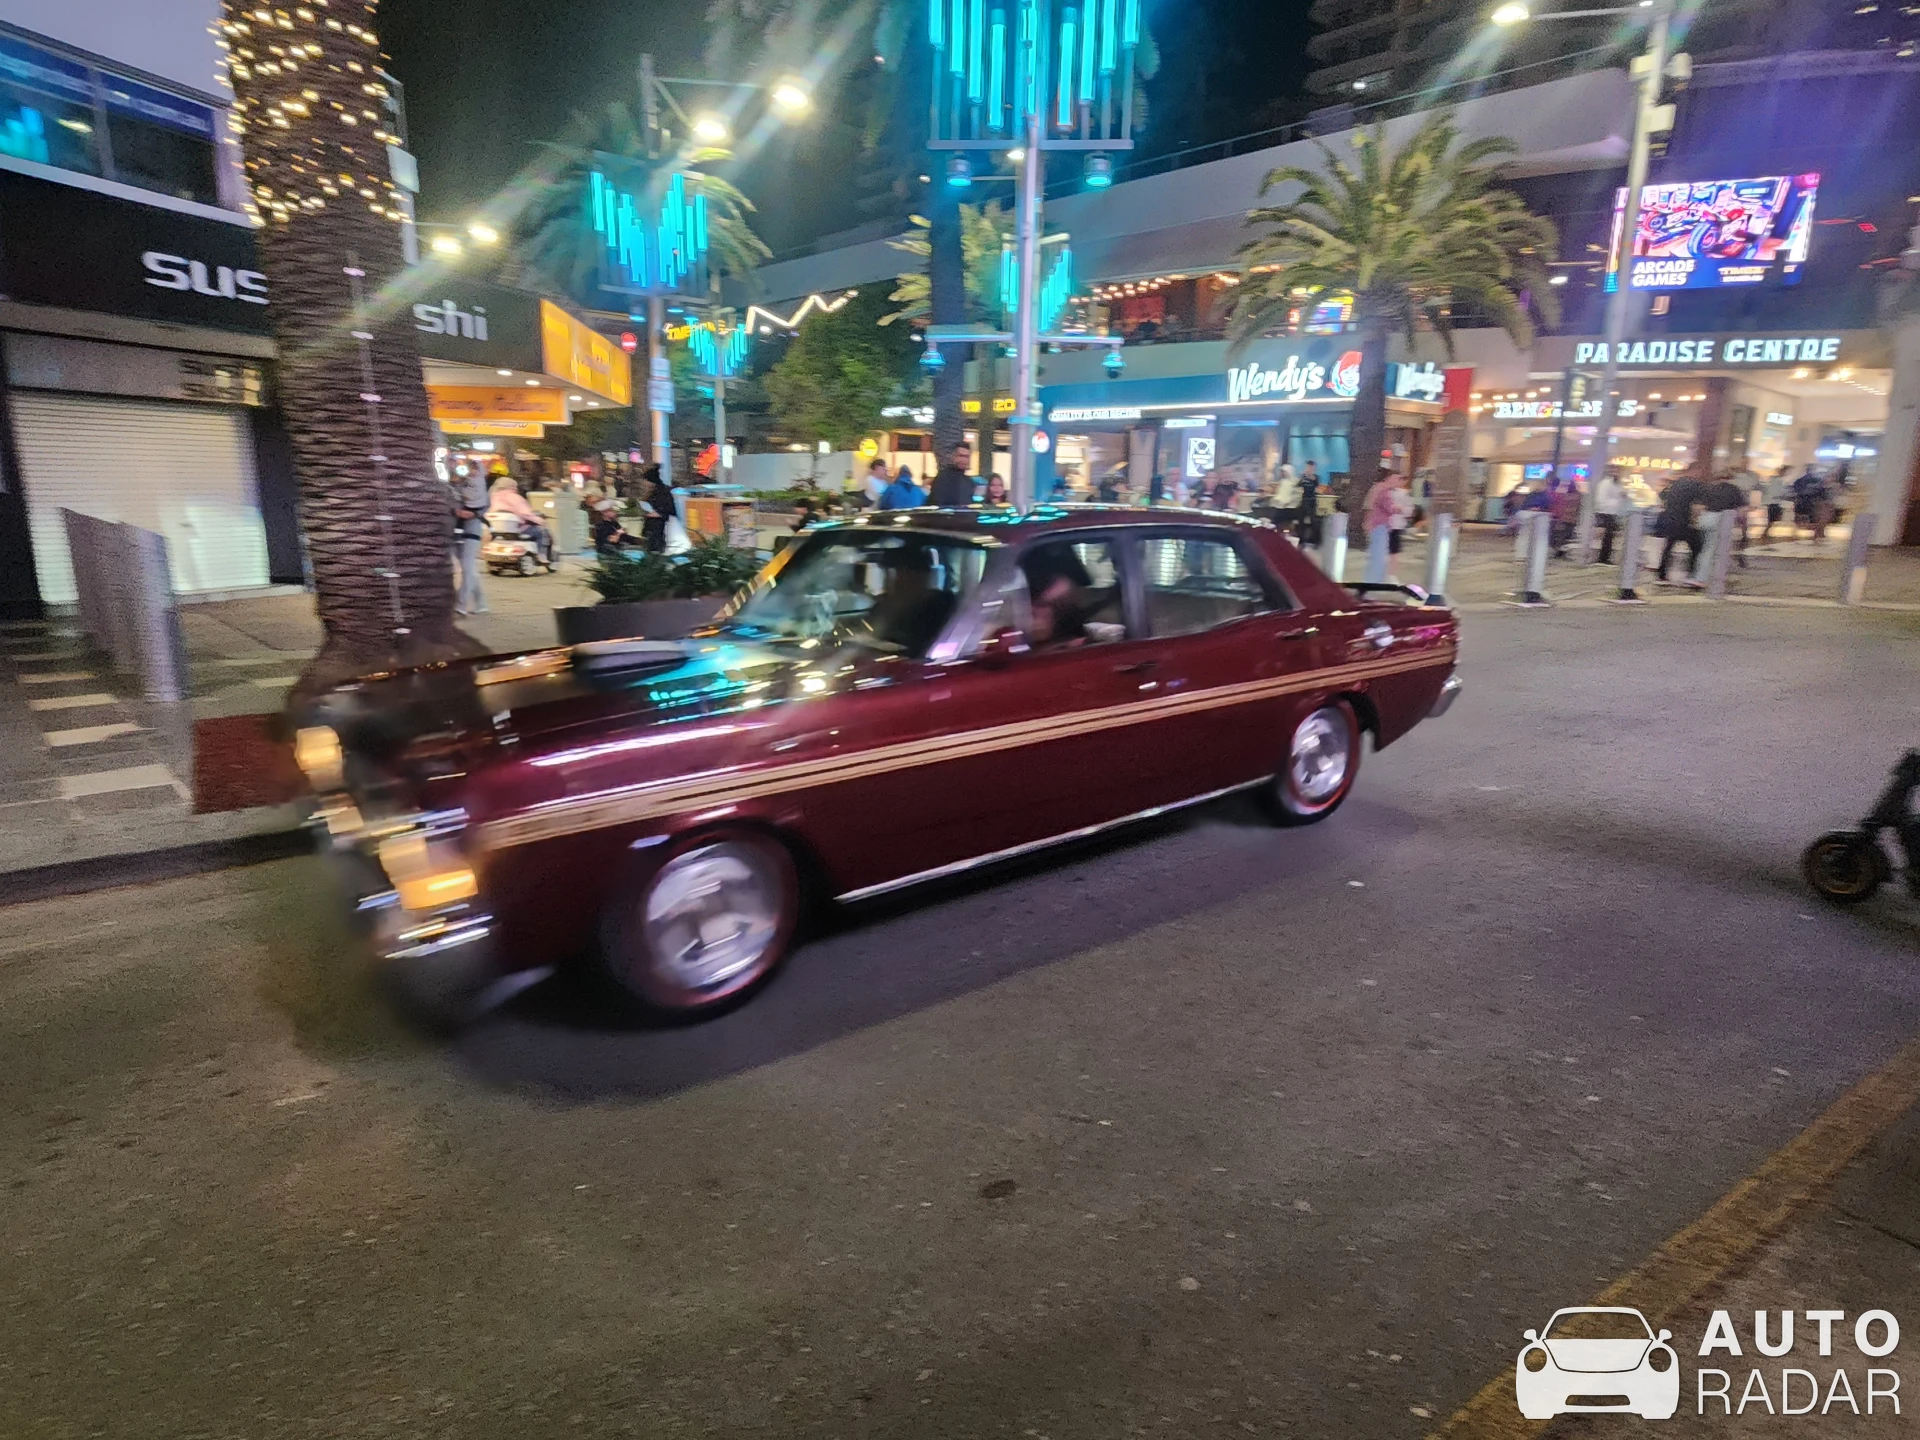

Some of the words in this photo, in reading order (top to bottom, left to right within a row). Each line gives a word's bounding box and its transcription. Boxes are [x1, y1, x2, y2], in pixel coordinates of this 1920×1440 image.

[1633, 260, 1695, 273] ARCADE
[1632, 273, 1687, 286] GAMES
[1575, 340, 1715, 363] PARADISE
[1722, 338, 1841, 362] CENTRE
[1228, 355, 1326, 403] Wendy's
